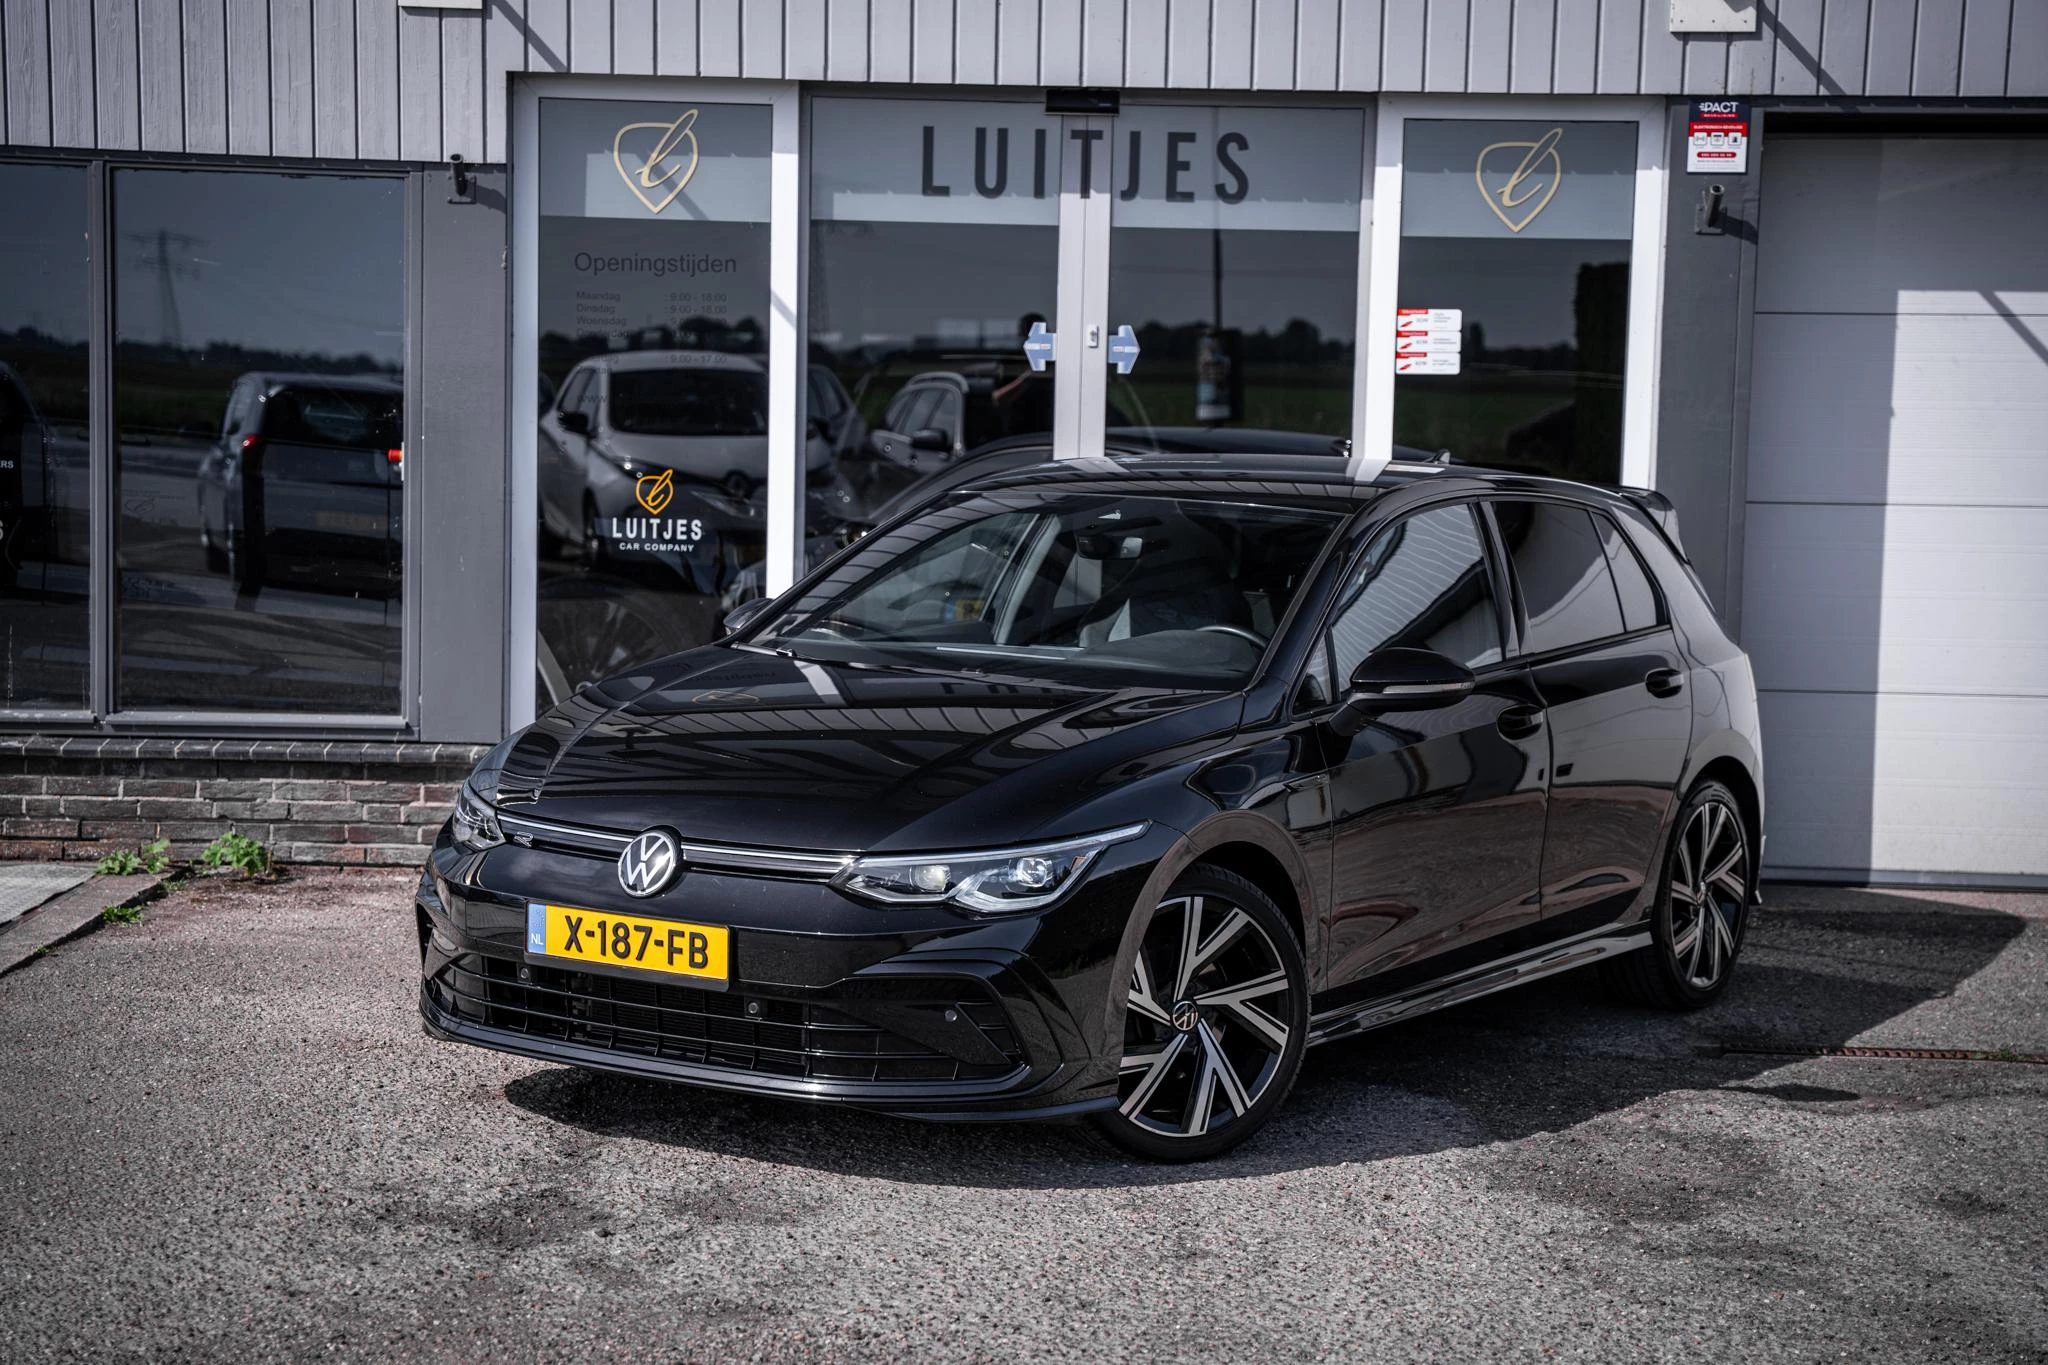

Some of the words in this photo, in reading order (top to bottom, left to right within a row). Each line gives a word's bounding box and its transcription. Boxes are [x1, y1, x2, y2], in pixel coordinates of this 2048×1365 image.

[922, 125, 1250, 204] LUITJES
[574, 251, 737, 278] Openingstijden
[576, 291, 621, 303] Maandag
[576, 303, 616, 315] Dinsdag
[576, 316, 627, 327] Woensdag
[612, 517, 703, 541] LUITJES
[619, 542, 640, 551] CAR
[644, 543, 694, 552] COMPANY
[531, 932, 544, 946] NL
[564, 914, 709, 969] X-187-FB
